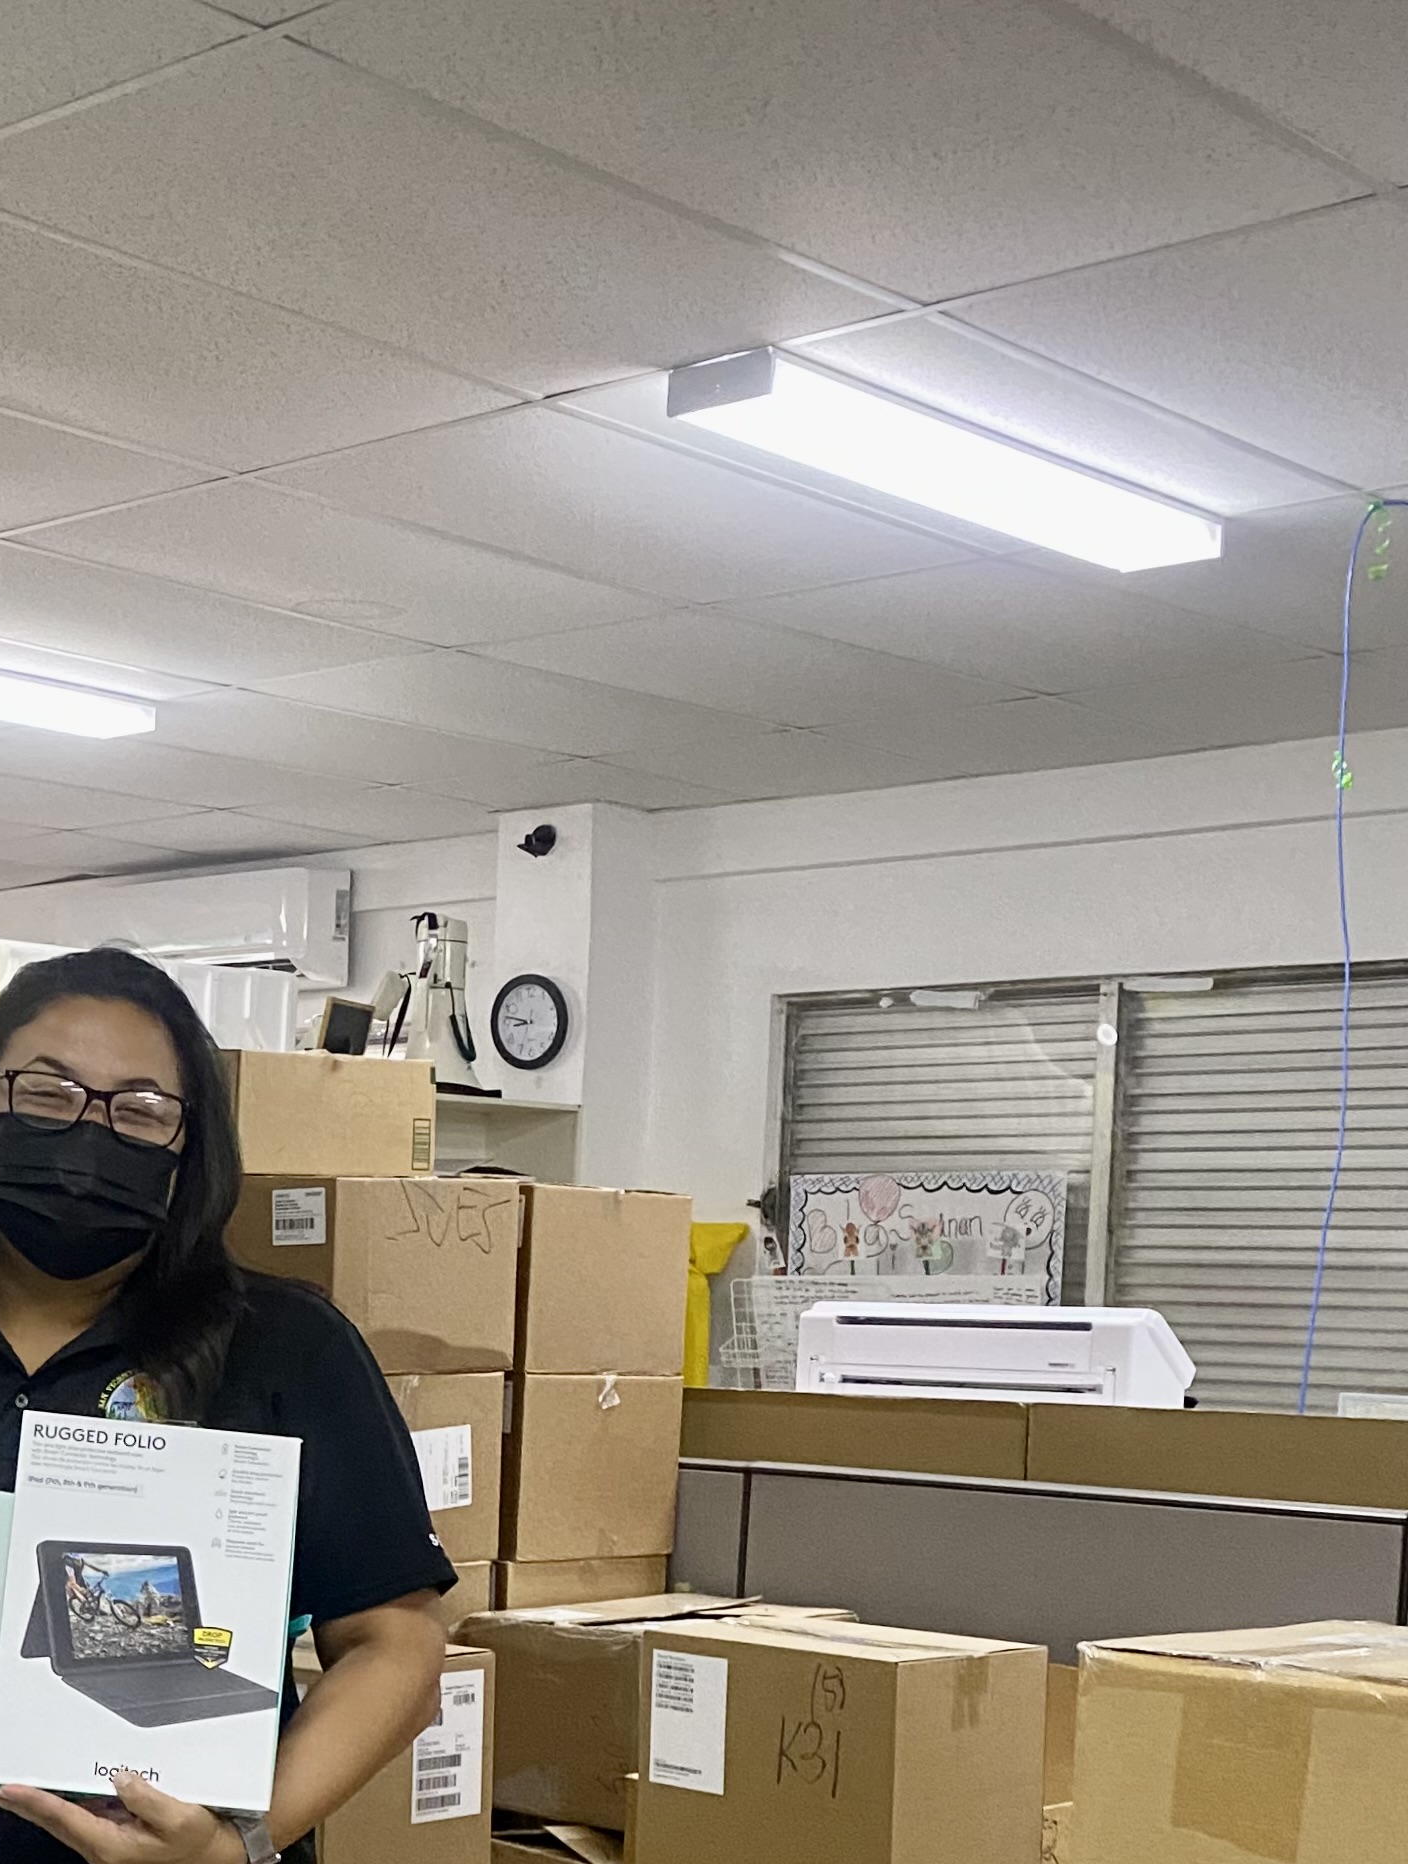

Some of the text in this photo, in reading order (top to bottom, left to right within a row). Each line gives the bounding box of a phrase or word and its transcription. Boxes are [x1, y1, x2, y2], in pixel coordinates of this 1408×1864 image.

[33, 1424, 166, 1451] RUGGED FOLIO
[776, 1715, 841, 1798] K31
